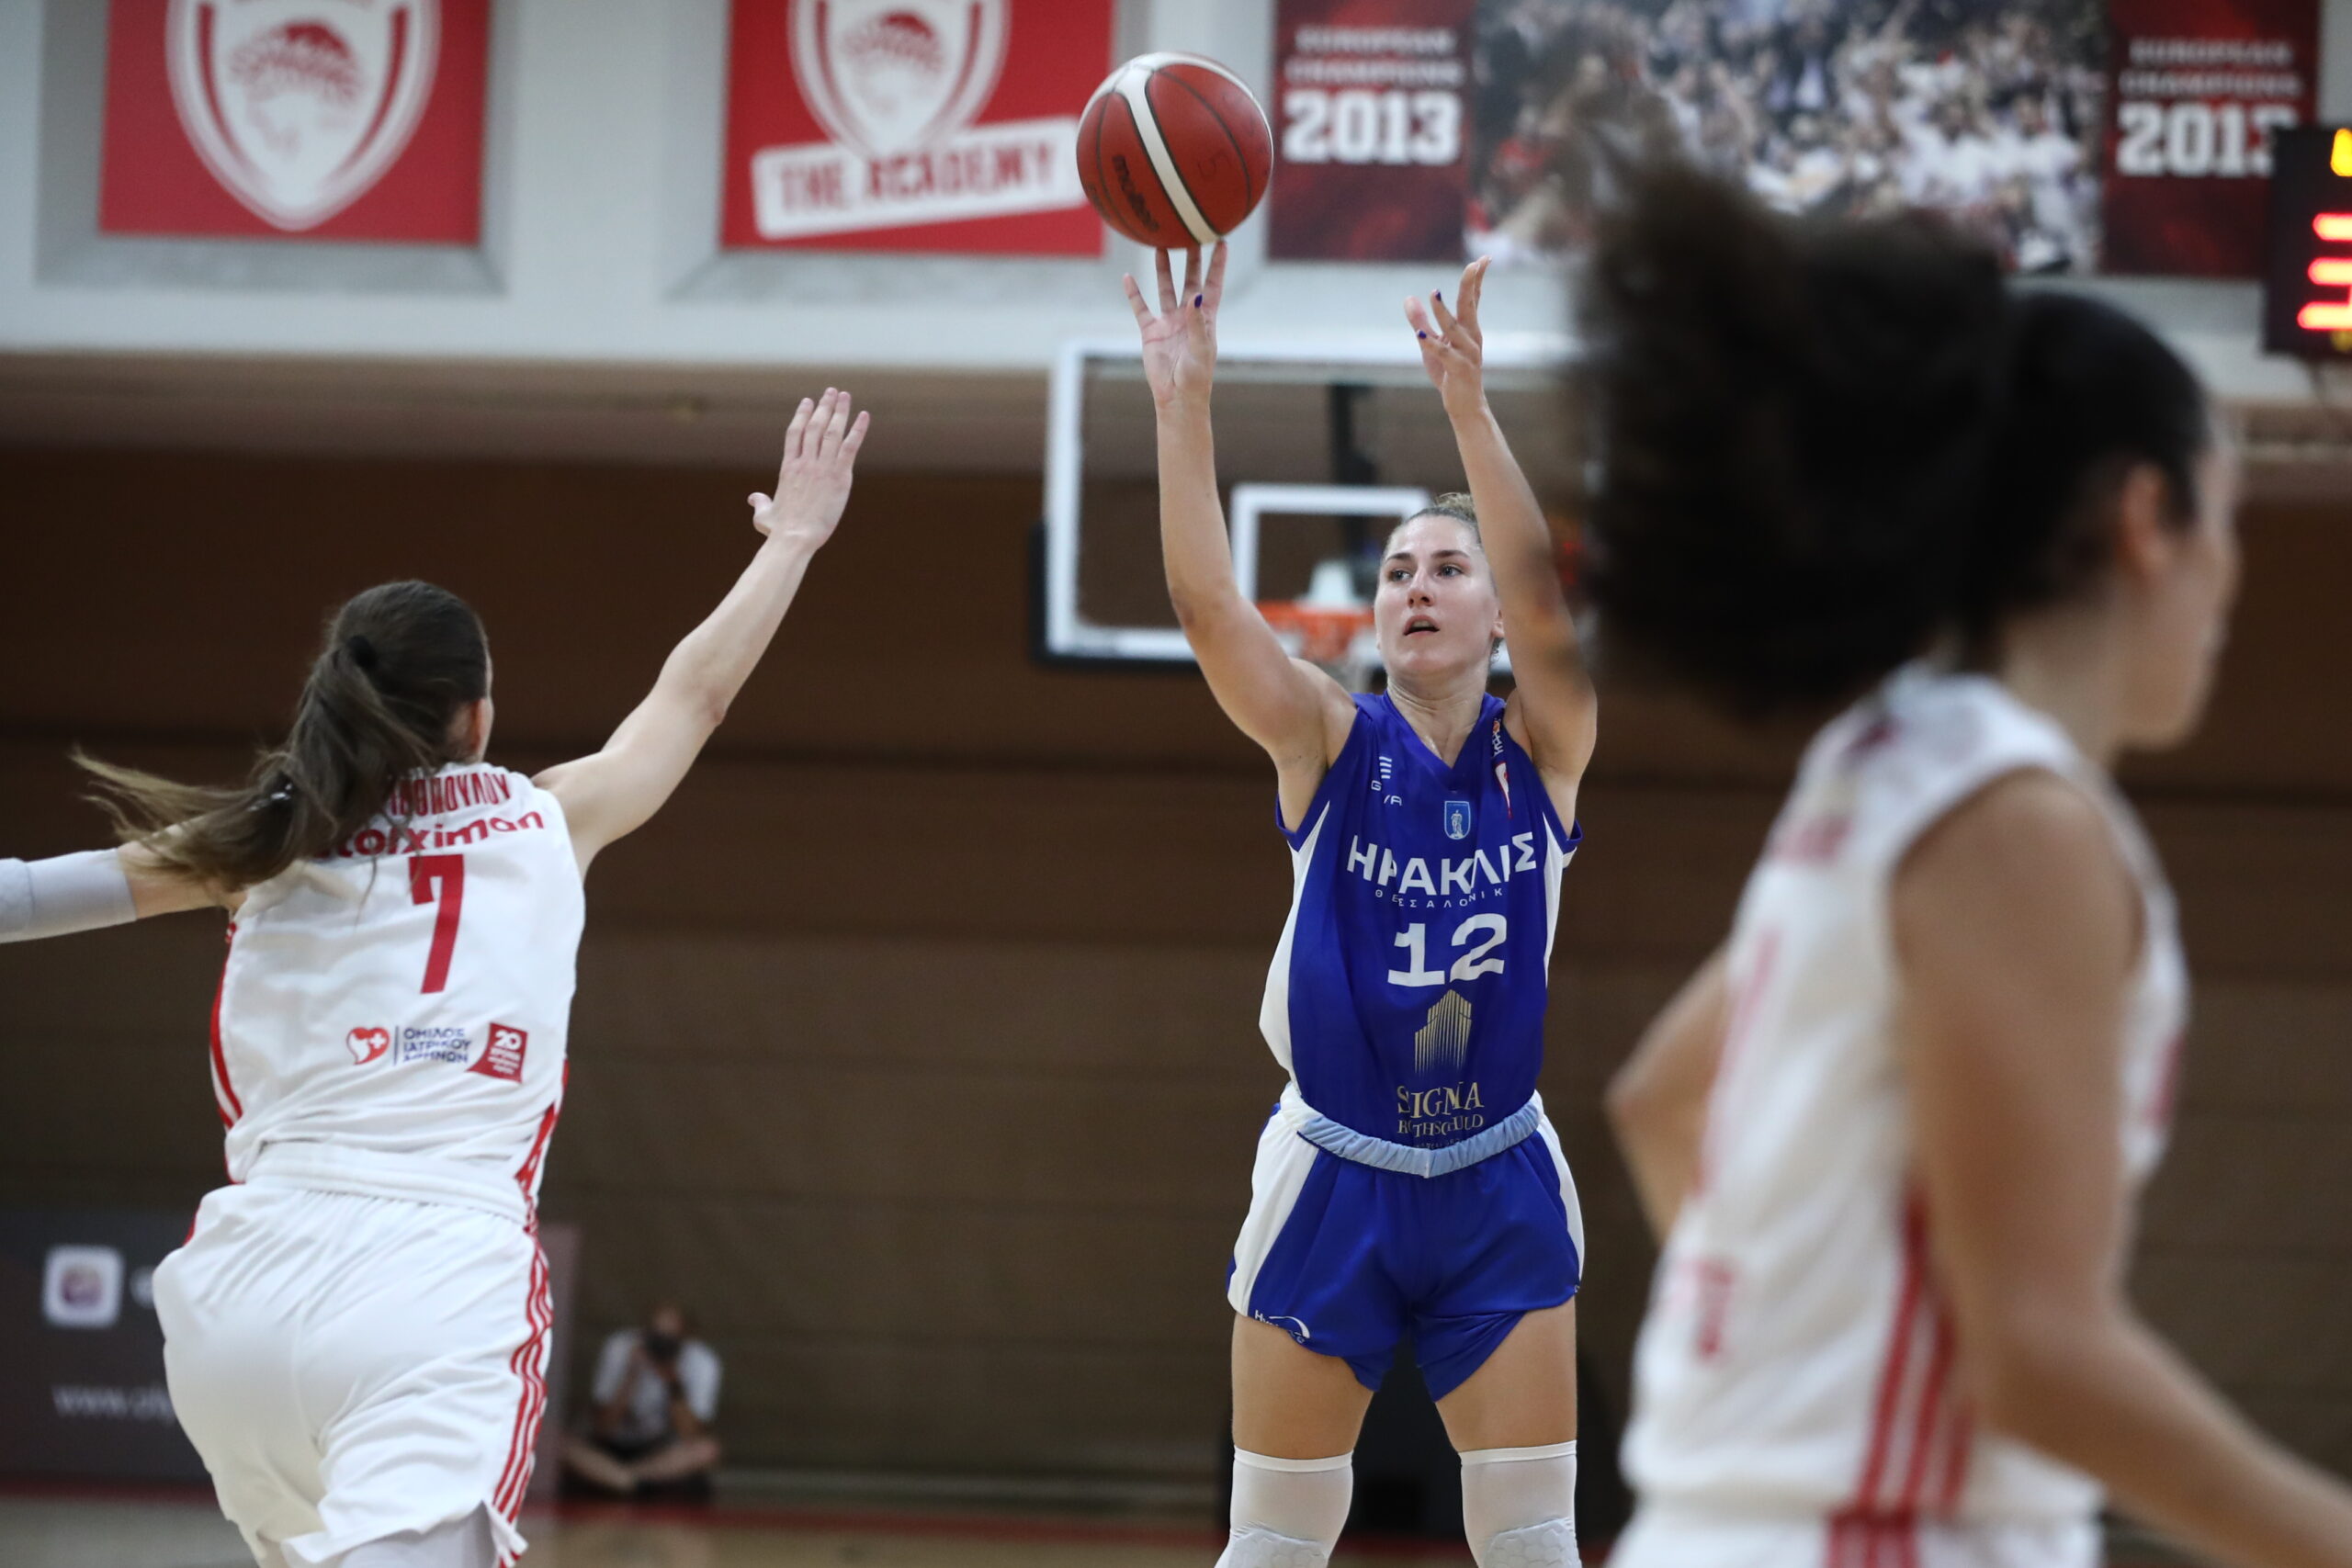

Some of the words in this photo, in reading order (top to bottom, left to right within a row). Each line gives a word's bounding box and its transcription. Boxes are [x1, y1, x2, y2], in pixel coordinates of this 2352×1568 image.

[1283, 90, 1462, 165] 2013
[778, 156, 854, 216] THE
[862, 138, 1057, 202] ACADEMY
[408, 853, 466, 995] 7
[1387, 913, 1508, 987] 12
